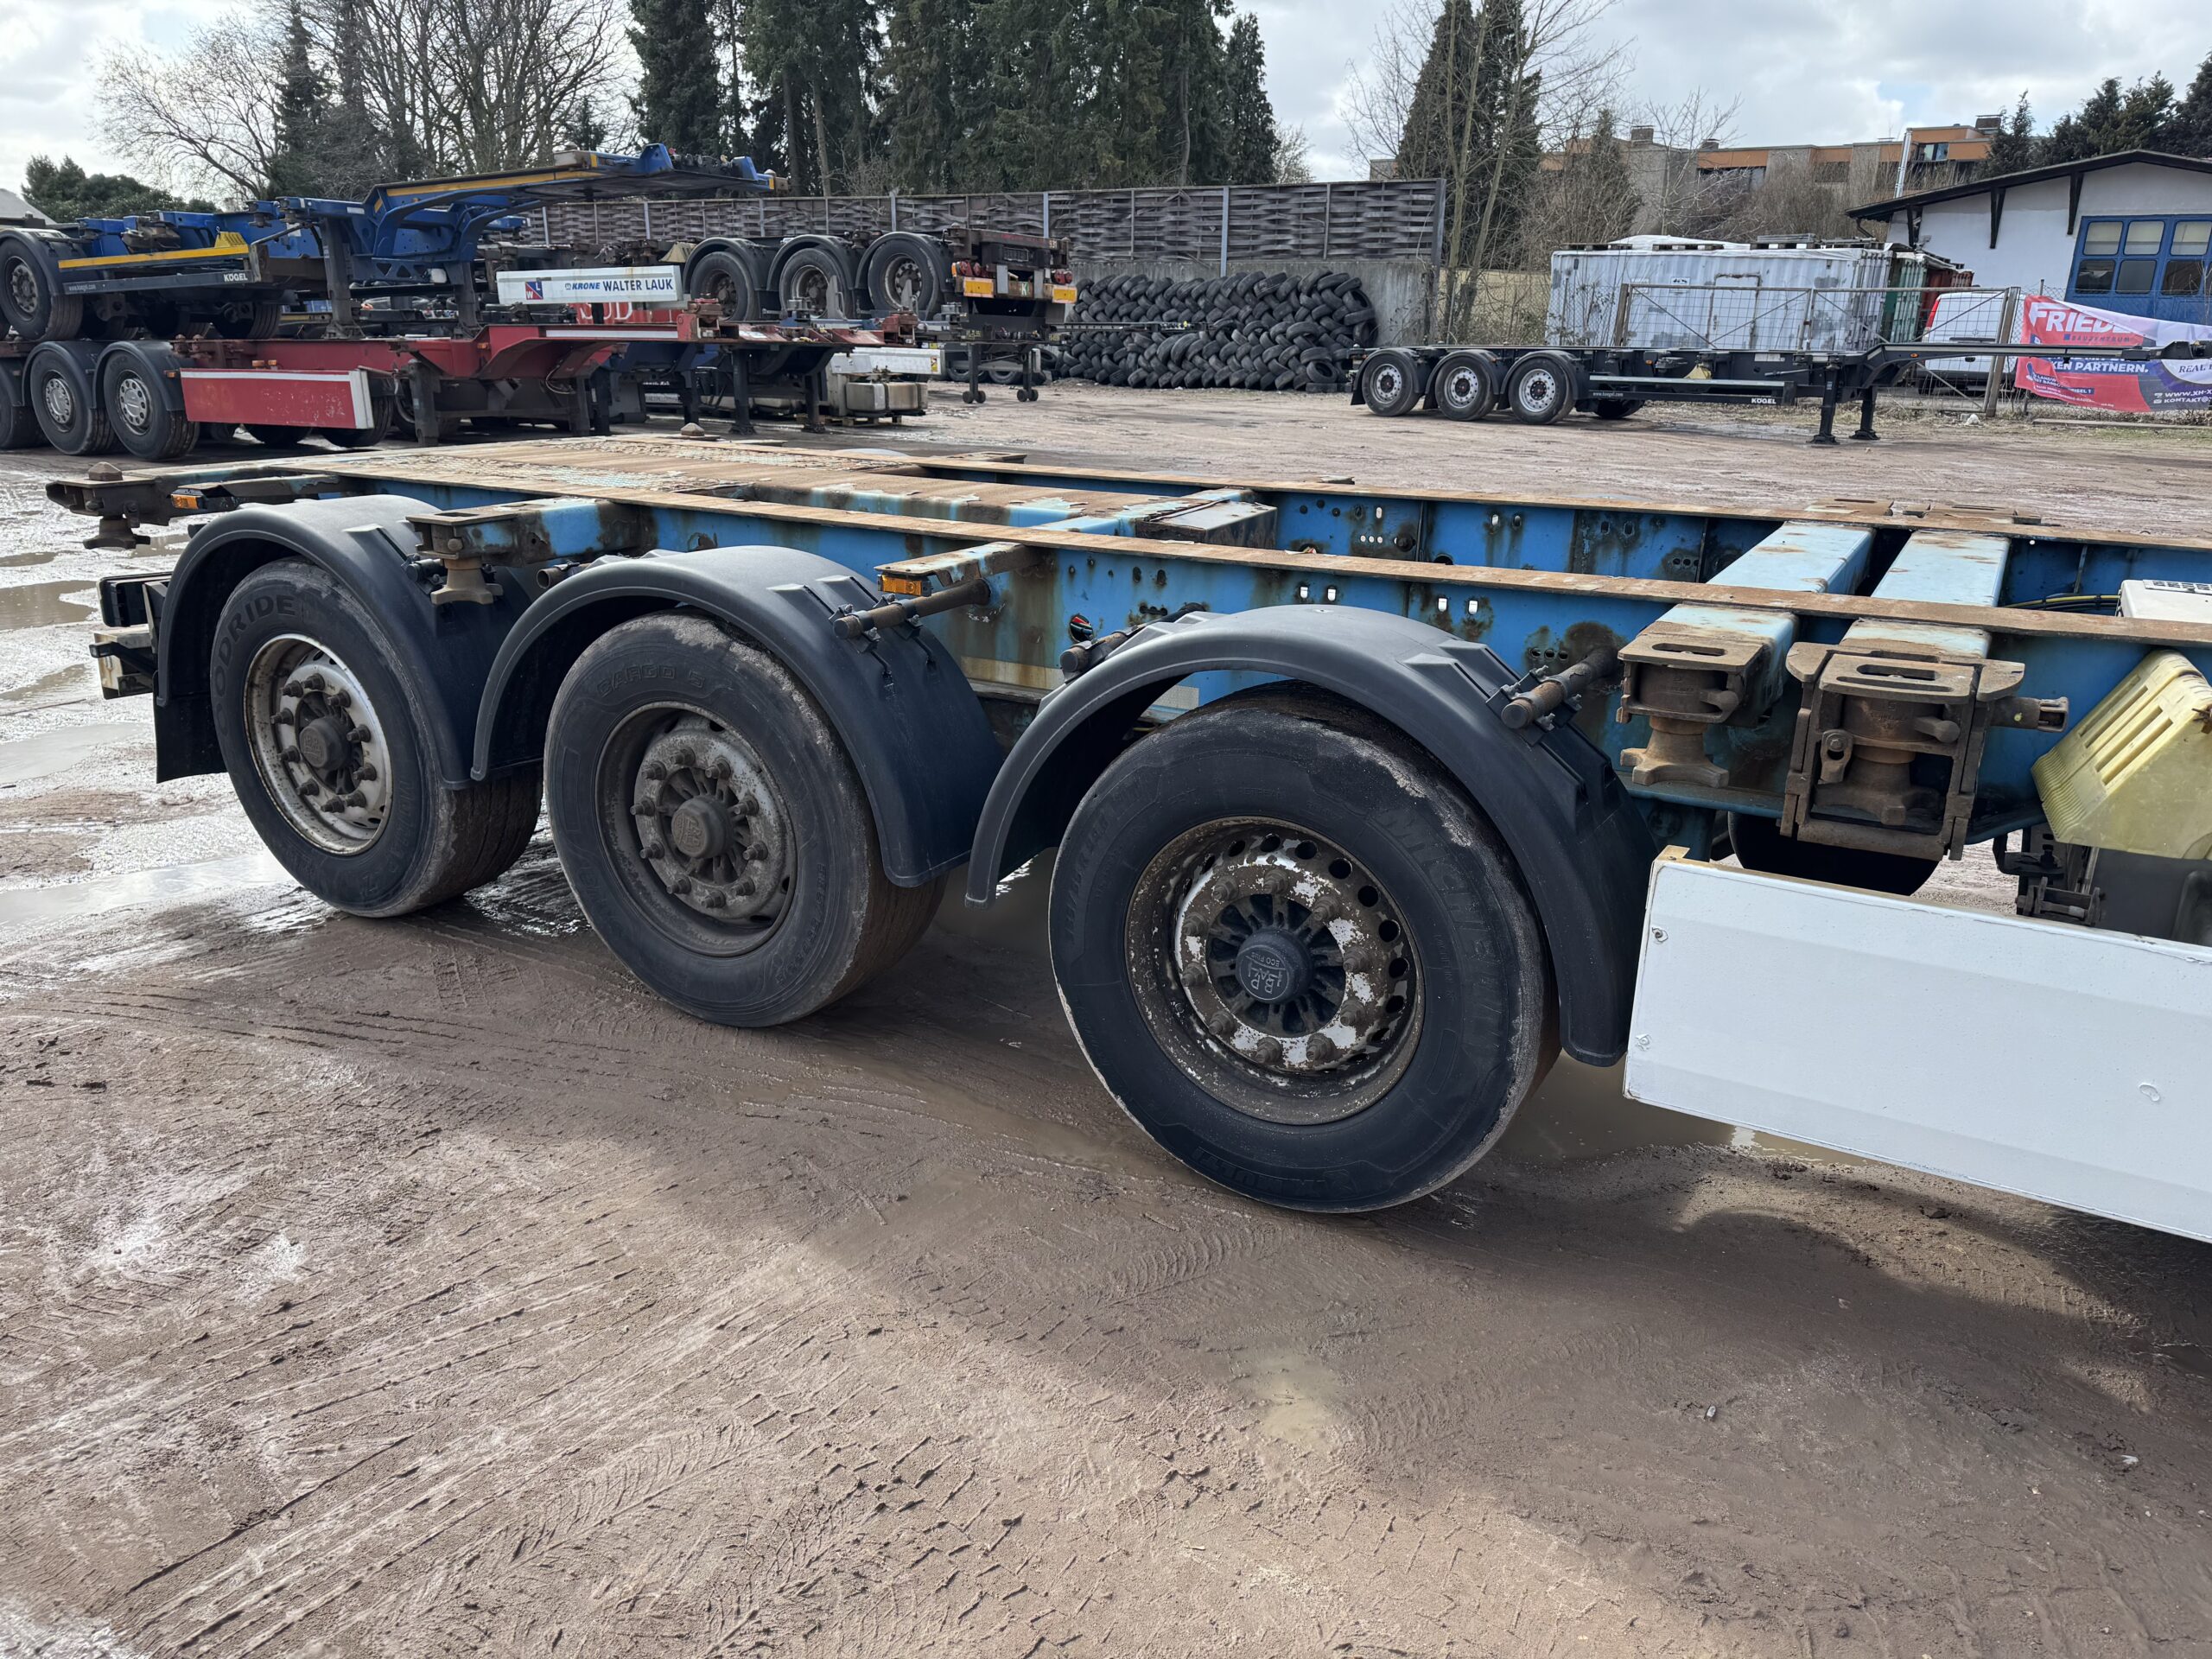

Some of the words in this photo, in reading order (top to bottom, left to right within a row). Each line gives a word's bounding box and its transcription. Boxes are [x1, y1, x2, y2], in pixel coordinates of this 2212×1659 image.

[572, 282, 601, 290] KRONE
[603, 280, 642, 292] WALTER
[645, 278, 673, 290] LAUK
[526, 290, 533, 299] W
[2075, 361, 2149, 373] PARTNERN.
[2179, 364, 2205, 373] REAL
